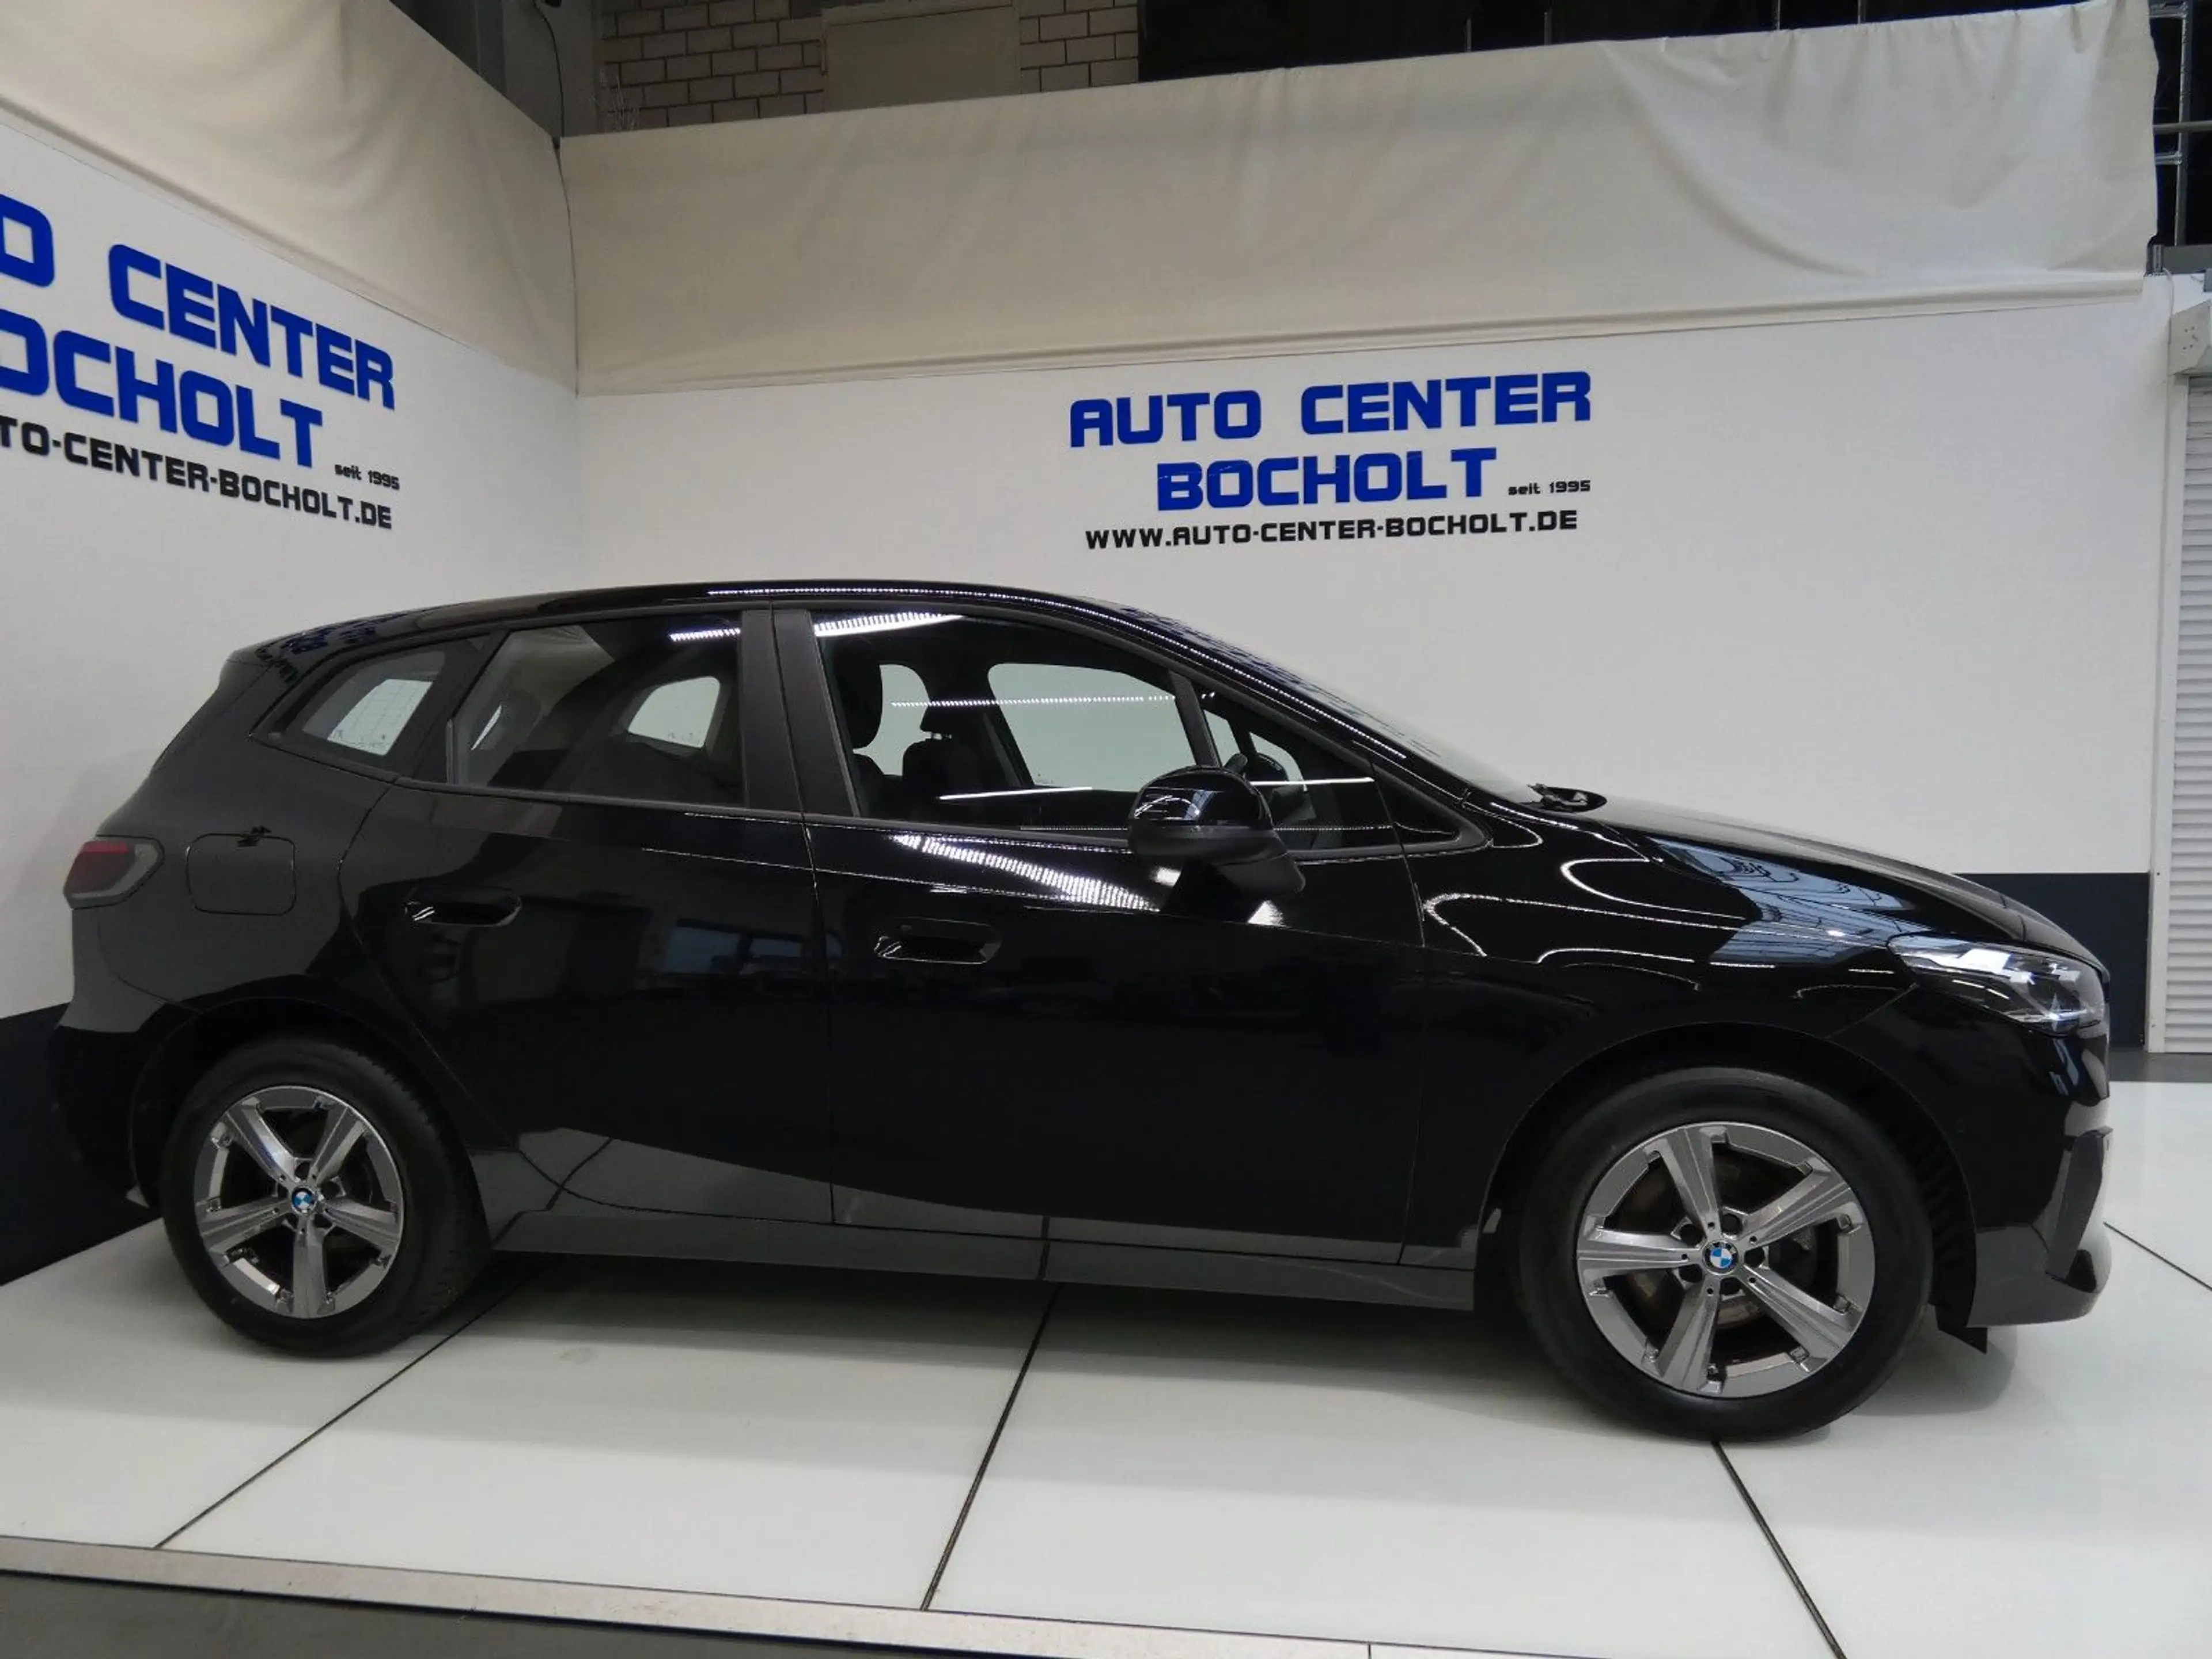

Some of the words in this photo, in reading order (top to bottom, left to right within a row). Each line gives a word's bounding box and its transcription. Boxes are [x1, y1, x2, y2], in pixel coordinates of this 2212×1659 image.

[108, 244, 395, 410] CENTER
[0, 308, 323, 468] OCHOLT
[1070, 390, 1262, 448] AUTO
[1301, 370, 1591, 435] CENTER
[0, 415, 392, 529] TO-CENTER-BOCHOLT.DE
[334, 464, 362, 481] seit
[368, 470, 400, 491] 1995
[1157, 447, 1497, 512] BOCHOLT
[1508, 482, 1541, 496] seit
[1549, 480, 1591, 494] 1995
[1085, 510, 1577, 550] WWW.AUTO-CENTER-BOCHOLT.DE
